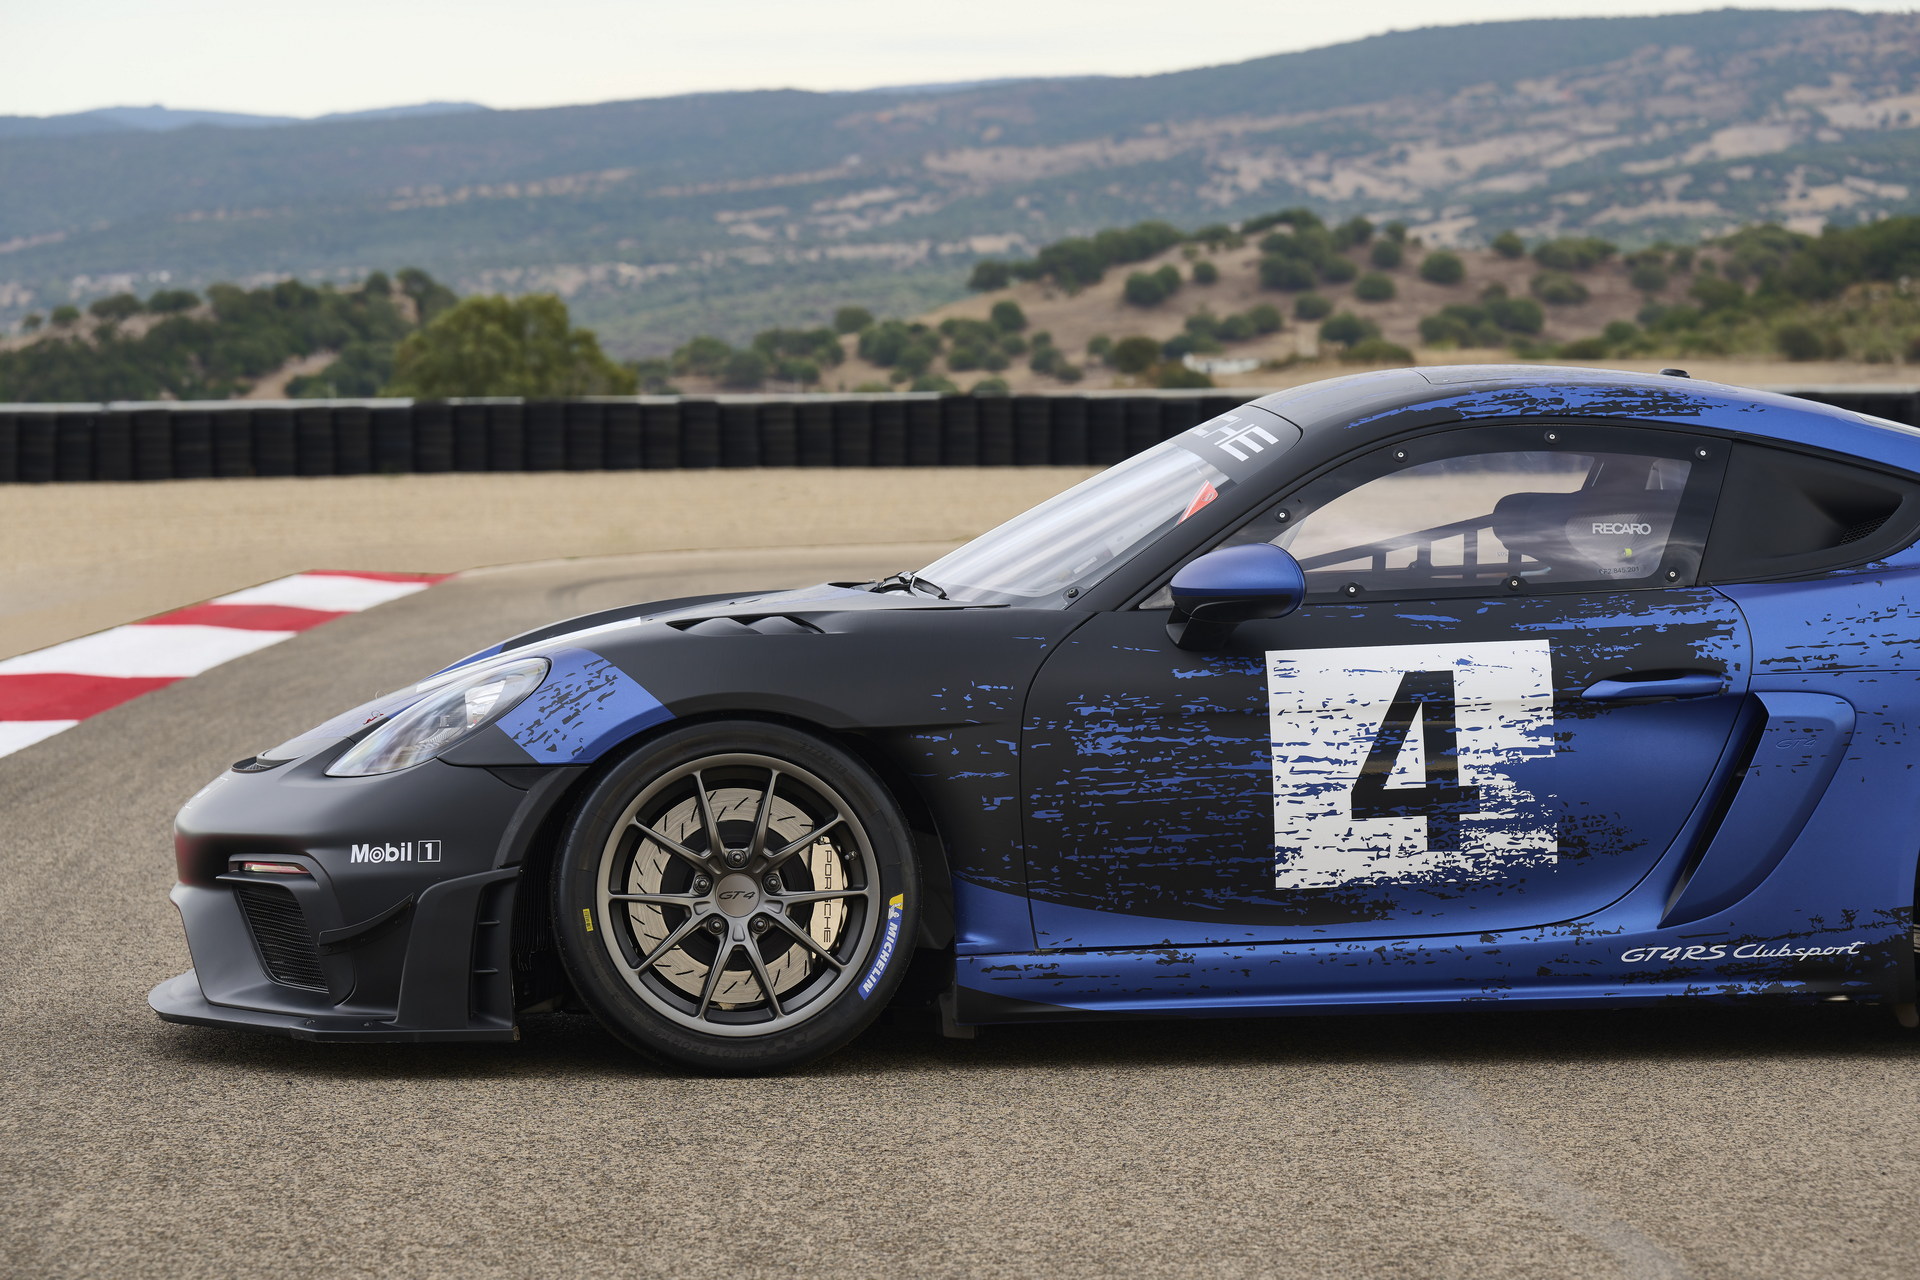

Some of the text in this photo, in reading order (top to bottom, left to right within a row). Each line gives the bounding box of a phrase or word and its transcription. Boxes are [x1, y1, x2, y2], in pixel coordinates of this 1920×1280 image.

[1592, 523, 1651, 535] RECARO
[1351, 670, 1480, 851] 4
[350, 842, 412, 863] Mobil
[719, 891, 756, 900] GT4
[823, 850, 833, 943] PORCHE
[862, 921, 898, 993] MICHELIN
[1732, 940, 1866, 962] Clubsport
